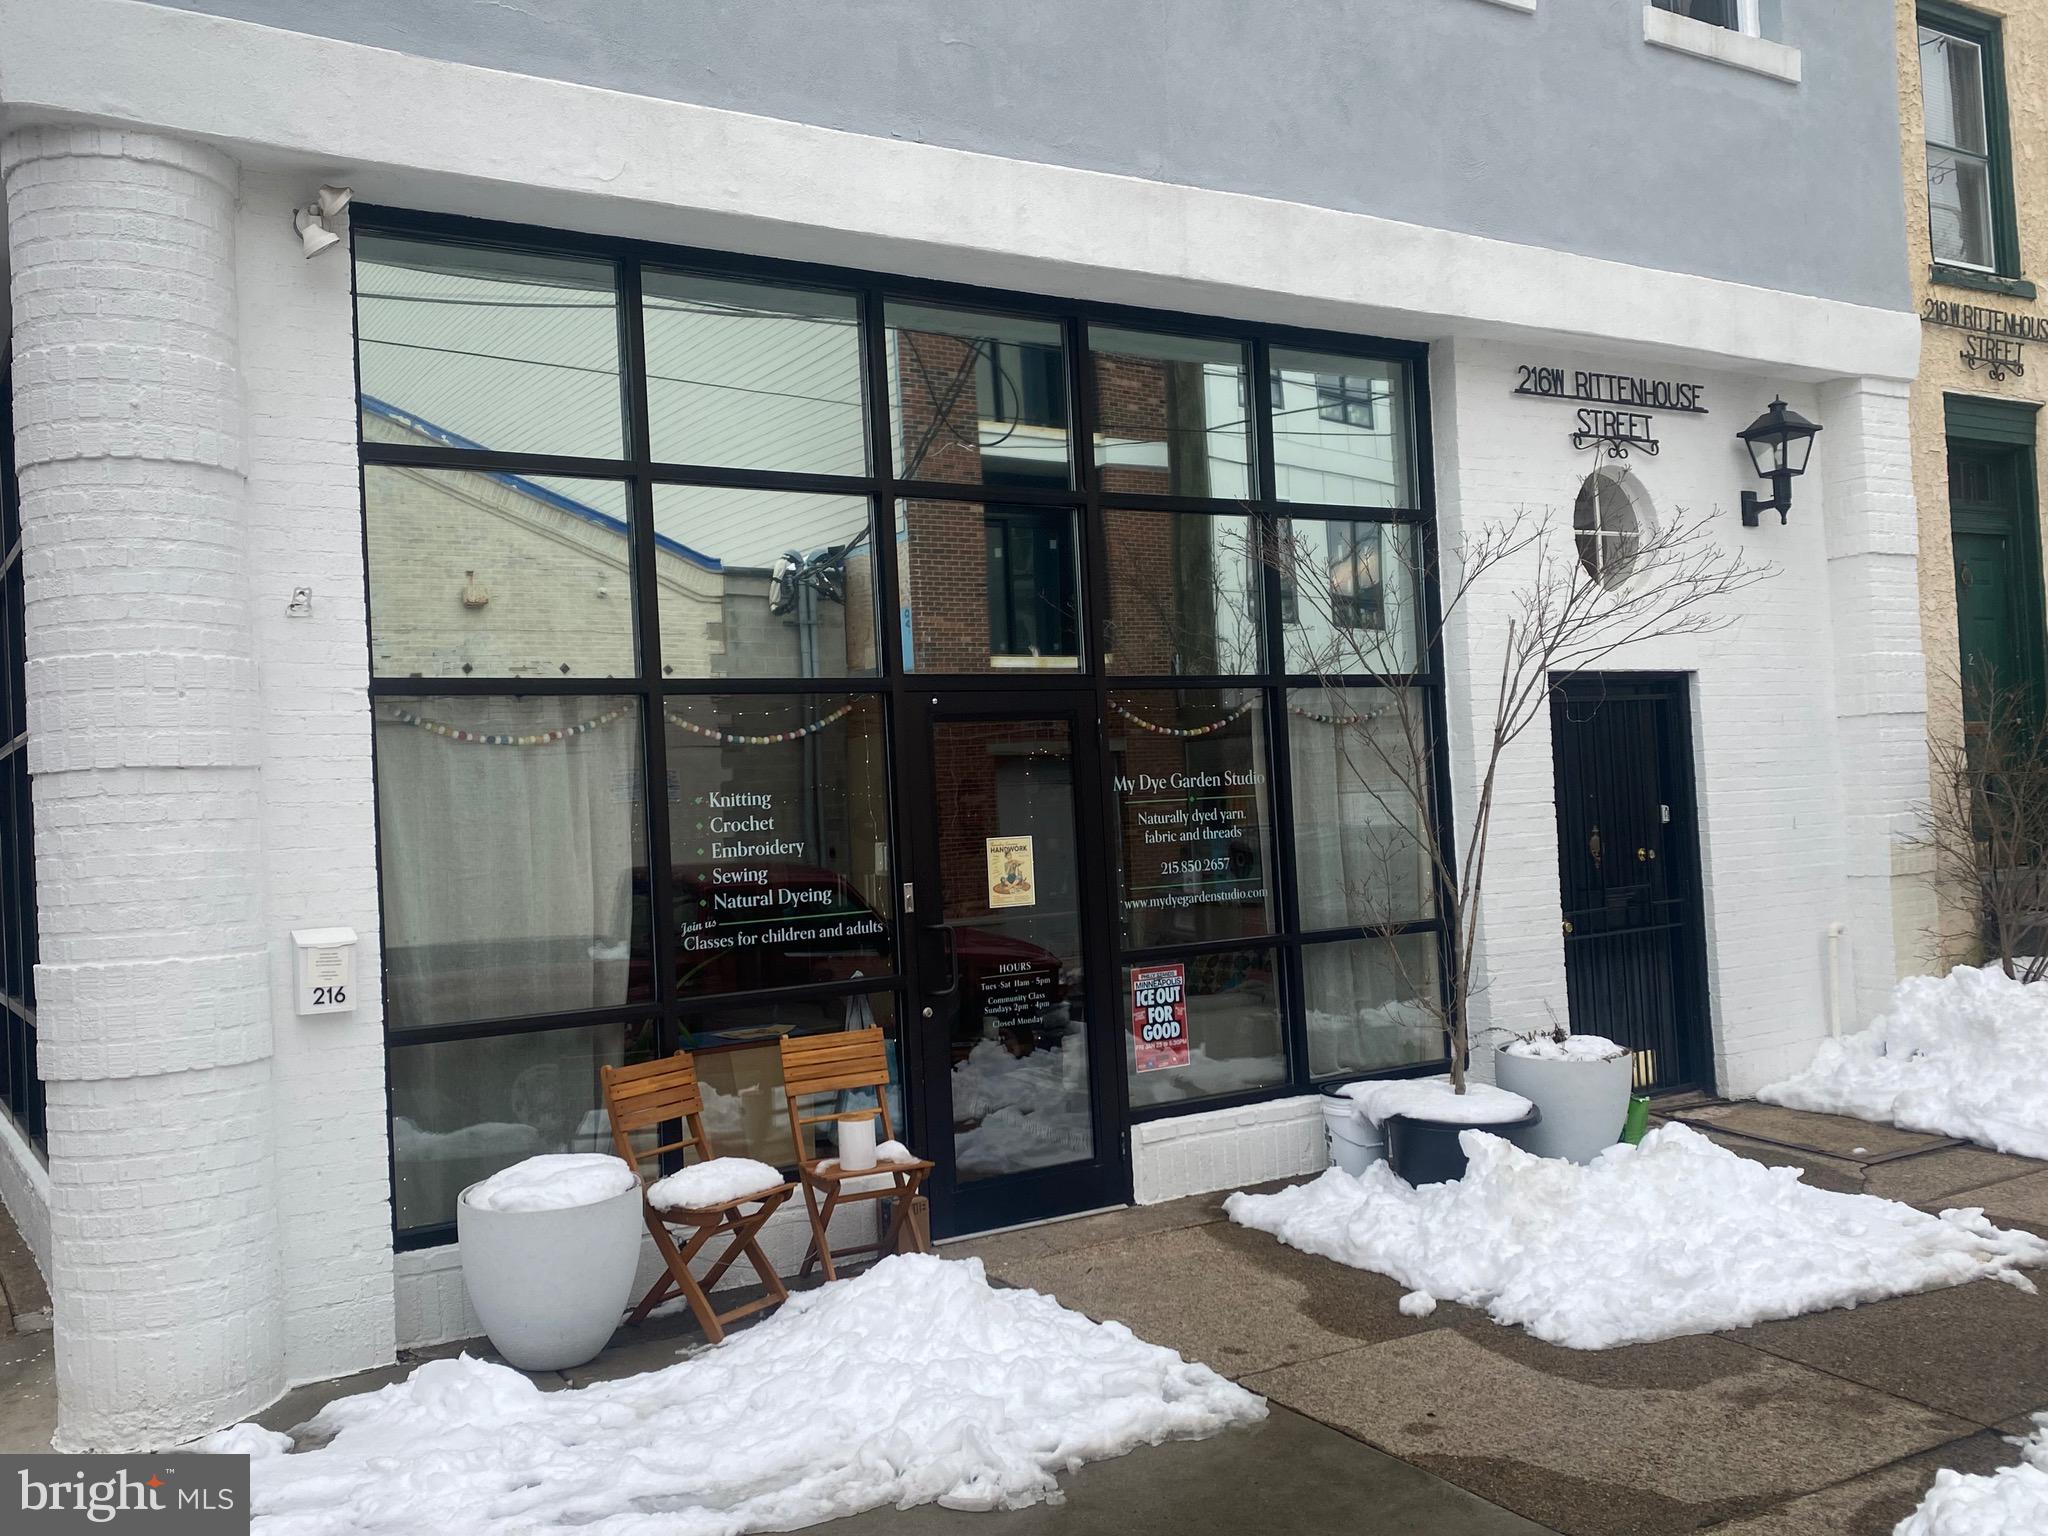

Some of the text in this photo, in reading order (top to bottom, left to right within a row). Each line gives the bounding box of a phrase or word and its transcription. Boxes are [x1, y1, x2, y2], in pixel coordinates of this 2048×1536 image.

[1925, 298, 1948, 322] 218
[1951, 302, 1960, 326] W
[1966, 335, 2024, 364] STREET
[1518, 365, 1704, 410] 216W RITTENHOUSE
[1577, 408, 1652, 440] STREET
[1113, 769, 1265, 795] My Dye Garden Studio
[709, 792, 772, 810] Knitting
[710, 816, 774, 833] Crochet
[1138, 809, 1189, 826] Naturally
[1191, 808, 1218, 825] dyed
[1145, 825, 1242, 844] fabric and threads
[712, 838, 805, 859] Embroidery
[990, 845, 1028, 853] HANDWORK
[1160, 857, 1230, 875] 215.850.2657
[712, 867, 768, 885] Sewing
[714, 887, 833, 910] Natural Dyeing
[1124, 888, 1268, 910] www.mydyegardenstudio.com
[681, 919, 717, 937] Join us
[684, 919, 884, 951] Classes for children and adults
[999, 961, 1032, 973] HOURS
[1035, 976, 1051, 986] 5pm
[1136, 977, 1182, 989] MINNEAPOLIS
[313, 986, 346, 1005] 216
[987, 992, 1046, 1005] Community Class
[1136, 986, 1181, 1007] ICE OUT
[984, 1004, 1012, 1015] Sundays
[1013, 1002, 1029, 1012] 2pm
[1034, 1001, 1050, 1010] 4pm
[1147, 1005, 1173, 1024] FOR
[992, 1014, 1044, 1028] Closed Monday
[1143, 1021, 1180, 1042] GOOD
